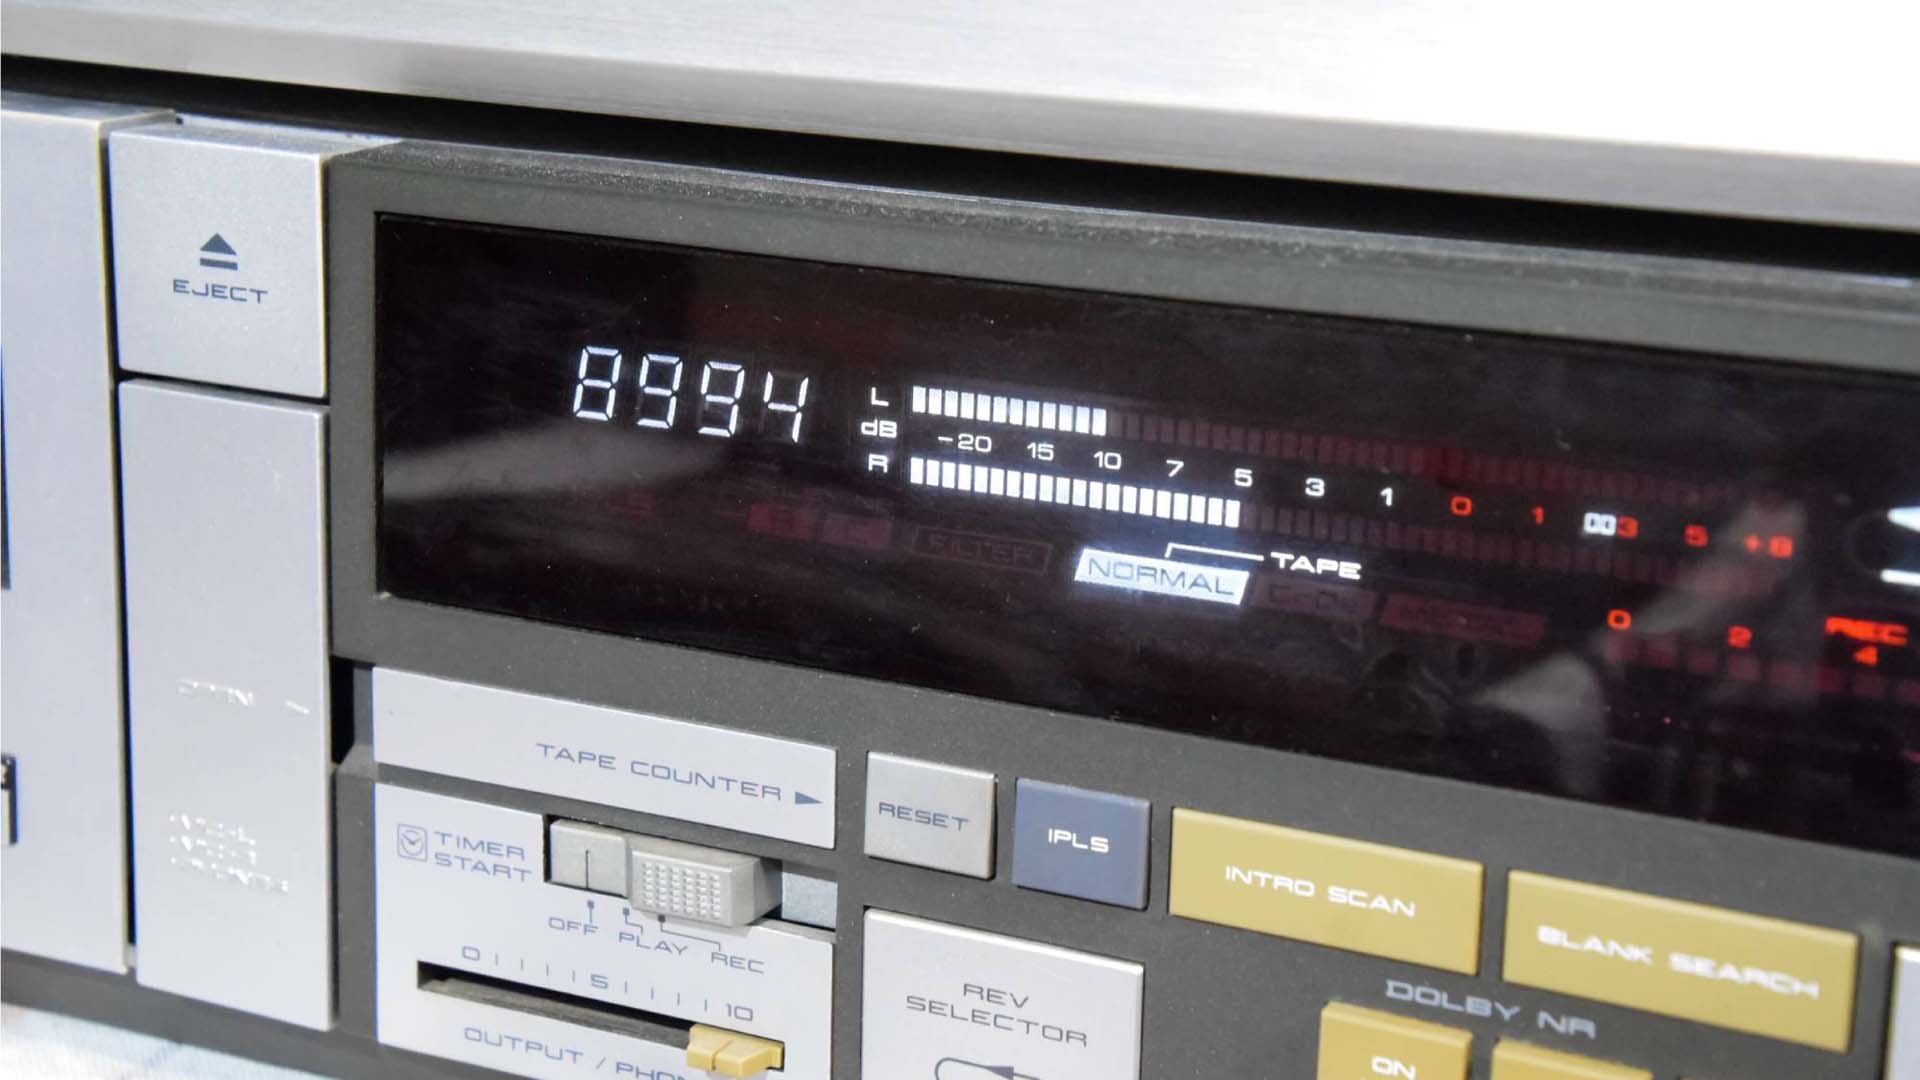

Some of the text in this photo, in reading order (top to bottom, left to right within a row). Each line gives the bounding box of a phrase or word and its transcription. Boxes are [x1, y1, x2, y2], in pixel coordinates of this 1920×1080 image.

[173, 279, 268, 304] EJECT
[572, 346, 809, 442] 8994
[870, 387, 889, 406] L
[860, 419, 897, 438] dB
[868, 454, 889, 472] R
[1027, 442, 1055, 461] 15
[1093, 451, 1122, 470] 10
[1166, 459, 1184, 478] 7
[1234, 468, 1253, 487] 5
[1305, 477, 1325, 497] 3
[1380, 487, 1393, 506] 1
[1451, 496, 1472, 516] 0
[1532, 506, 1544, 525] 1
[1616, 516, 1638, 538] 3
[1088, 557, 1234, 596] NORMAL
[1270, 551, 1362, 580] TAPE
[1607, 609, 1631, 630] 0
[536, 743, 782, 801] TAPE COUNTER
[878, 802, 969, 832] RESET
[434, 831, 526, 861] TIMER
[1048, 827, 1110, 854] IPLS
[434, 852, 532, 882] START
[1225, 865, 1416, 917] INTRO SCAN
[548, 917, 599, 936] OFF
[619, 931, 688, 957] PLAY
[710, 951, 766, 974] REC
[1537, 924, 1820, 999] BLANK SEARCH
[461, 945, 753, 1022] 0 5 10
[963, 982, 1030, 1009] REV
[905, 994, 1088, 1048] SELECTOR
[1386, 979, 1597, 1040] DOLBY NR
[464, 1026, 584, 1065] OUTPUT
[1371, 1055, 1416, 1080] ON
